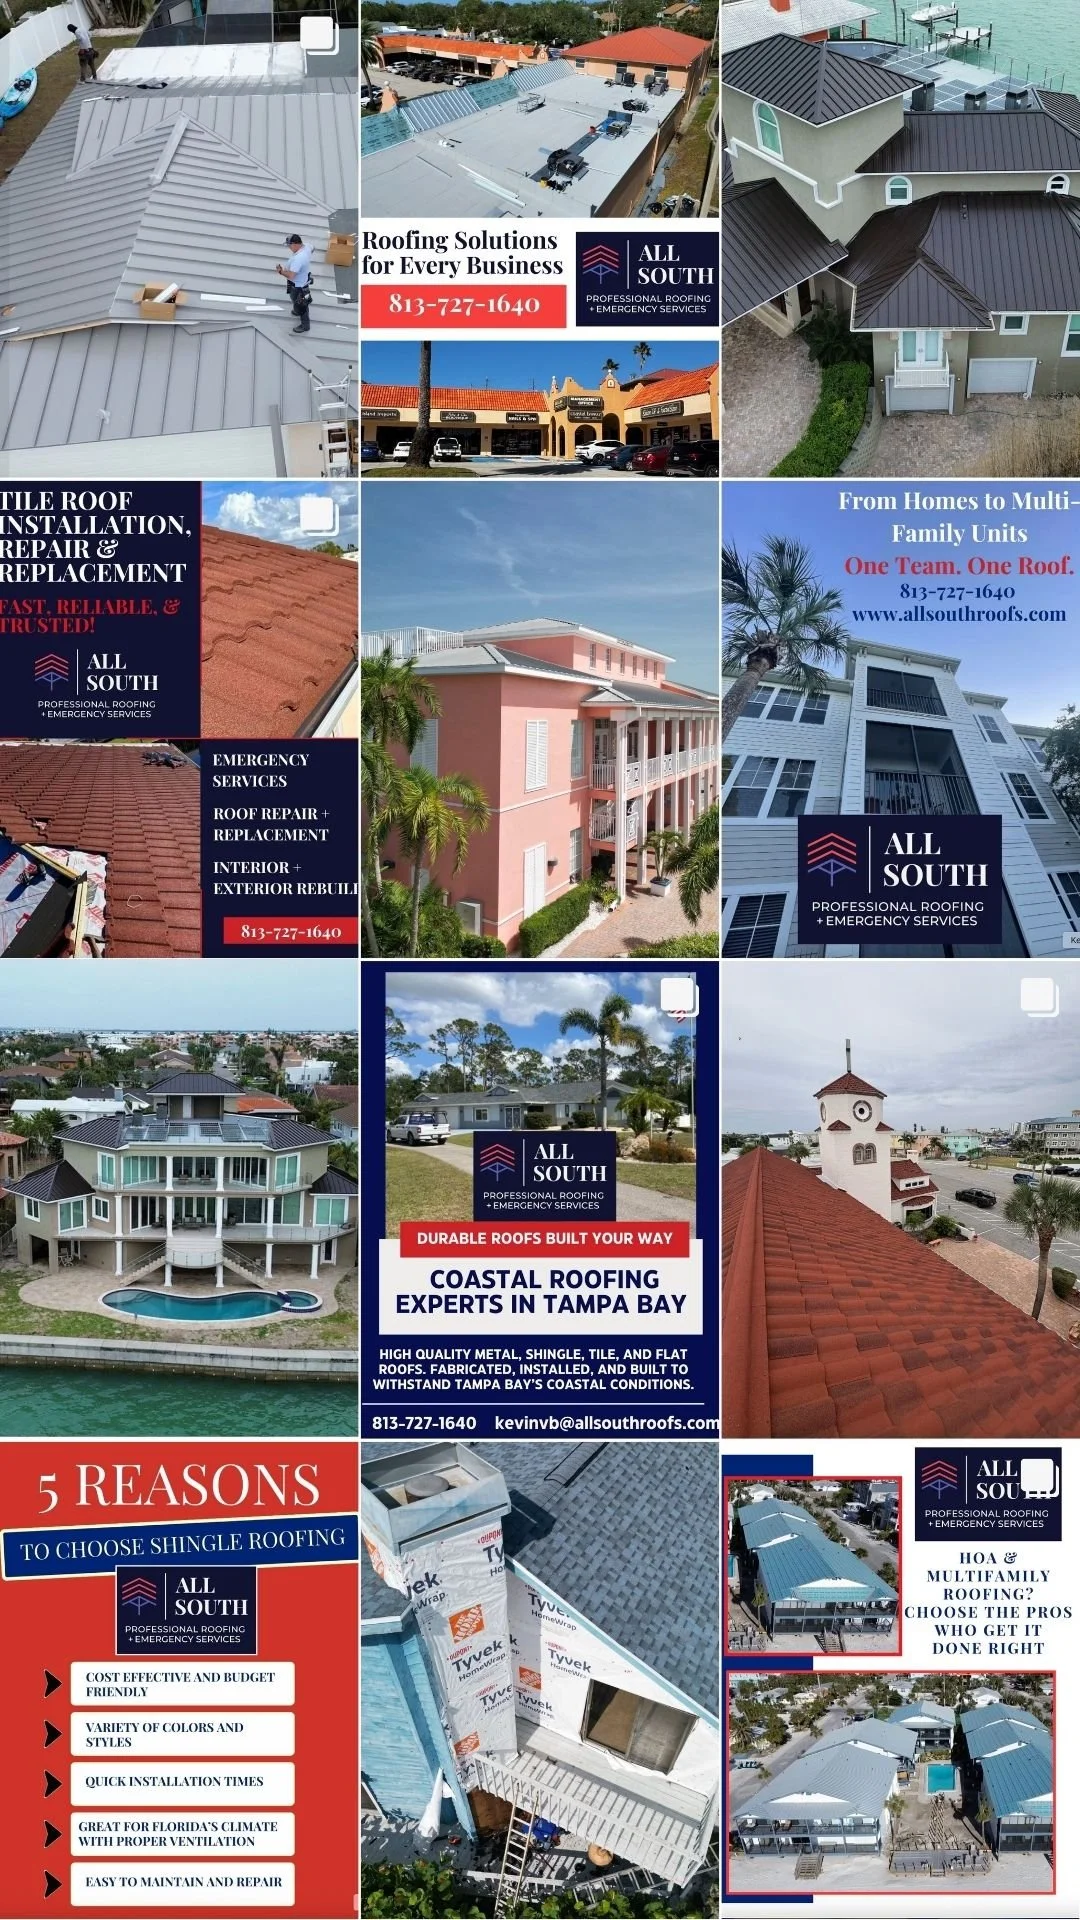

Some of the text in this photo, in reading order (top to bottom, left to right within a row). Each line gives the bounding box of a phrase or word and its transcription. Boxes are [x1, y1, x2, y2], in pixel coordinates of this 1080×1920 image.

[362, 230, 557, 253] Roofing Solutions
[639, 245, 679, 261] ALL
[362, 255, 563, 278] for Every Business
[638, 268, 714, 284] SOUTH
[389, 294, 540, 316] 813-727-1640
[586, 294, 711, 303] PROFESSIONAL ROOFING
[596, 304, 707, 313] EMERGENCY SERVICES
[0, 491, 132, 510] TILE ROOF
[840, 491, 1080, 510] From Homes to Multi-
[0, 515, 191, 537] INSTALLATION,
[892, 523, 1027, 546] Family Units
[0, 539, 118, 558] REPAIR &
[0, 563, 186, 582] REPLACEMENT
[844, 556, 1073, 575] One Team. One Roof.
[900, 584, 1015, 601] 813-727-1640
[0, 600, 180, 616] FAST, RELIABLE, &
[852, 606, 1066, 621] www.allsouthroofs.com
[0, 617, 94, 633] TRUSTED!
[88, 654, 126, 669] ALL
[87, 675, 158, 691] SOUTH
[212, 753, 310, 767] EMERGENCY
[212, 774, 288, 788] SERVICES
[213, 807, 319, 821] ROOF REPAIR
[214, 828, 330, 842] REPLACEMENT
[884, 833, 940, 854] ALL
[213, 861, 290, 874] INTERIOR
[884, 864, 988, 886] SOUTH
[213, 882, 294, 895] EXTERIOR
[812, 901, 984, 912] PROFESSIONAL ROOFING
[826, 915, 978, 927] EMERGENCY SERVICES
[242, 925, 341, 940] 813-727-1640
[534, 1144, 573, 1159] ALL
[534, 1166, 607, 1181] SOUTH
[417, 1231, 673, 1245] DURABLE ROOFS BUILT YOUR WAY
[431, 1270, 659, 1289] COASTAL ROOFING
[397, 1295, 686, 1314] EXPERTS IN TAMPA BAY
[379, 1348, 688, 1362] HIGH QUALITY METAL, SHINGLE, TILE, AND FLAT
[378, 1363, 689, 1377] ROOFS. FABRICATED, INSTALLED, AND BUILT TO
[372, 1378, 452, 1390] WITHSTAND
[454, 1378, 502, 1390] TAMPA
[546, 1378, 607, 1390] COASTAL
[609, 1378, 695, 1390] CONDITIONS.
[372, 1416, 718, 1431] 813-727-1640 kevinvb@allsouthroofs.com
[977, 1460, 1017, 1476] ALL
[39, 1464, 320, 1513] 5 REASONS
[977, 1483, 1052, 1499] SOU
[924, 1509, 1049, 1518] PROFESSIONAL ROOFING
[935, 1519, 1045, 1528] EMERGENCY SERVICES
[20, 1528, 344, 1560] TO CHOOSE SHINGLE ROOFING
[959, 1551, 1018, 1565] HOA &
[927, 1569, 1050, 1583] MULTIFAMILY
[176, 1578, 215, 1593] ALL
[943, 1587, 1034, 1601] ROOFING?
[175, 1599, 248, 1615] SOUTH
[904, 1606, 1073, 1619] CHOOSE THE PROS
[125, 1625, 246, 1634] PROFESSIONAL ROOFING
[934, 1624, 1043, 1637] WHO GET IT
[133, 1635, 241, 1644] EMERGENCY SERVICES
[451, 1639, 503, 1672] Tyvek
[932, 1642, 1045, 1655] DONE RIGHT
[458, 1652, 506, 1681] HomeWrap
[547, 1647, 592, 1673] Tyvek
[85, 1672, 276, 1683] COST EFFECTIVE AND BUDGET
[86, 1686, 149, 1697] FRIENDLY
[515, 1690, 553, 1712] Tyvek
[85, 1722, 244, 1733] VARIETY OF COLORS AND
[85, 1737, 132, 1748] STYLES
[85, 1776, 264, 1789] QUICK INSTALLATION TIMES
[78, 1821, 121, 1832] GREAT
[123, 1821, 150, 1832] FOR
[220, 1821, 278, 1832] CLIMATE
[78, 1836, 255, 1847] WITH PROPER VENTILATION
[84, 1876, 283, 1888] EASY TO MAINTAIN AND REPAIR
